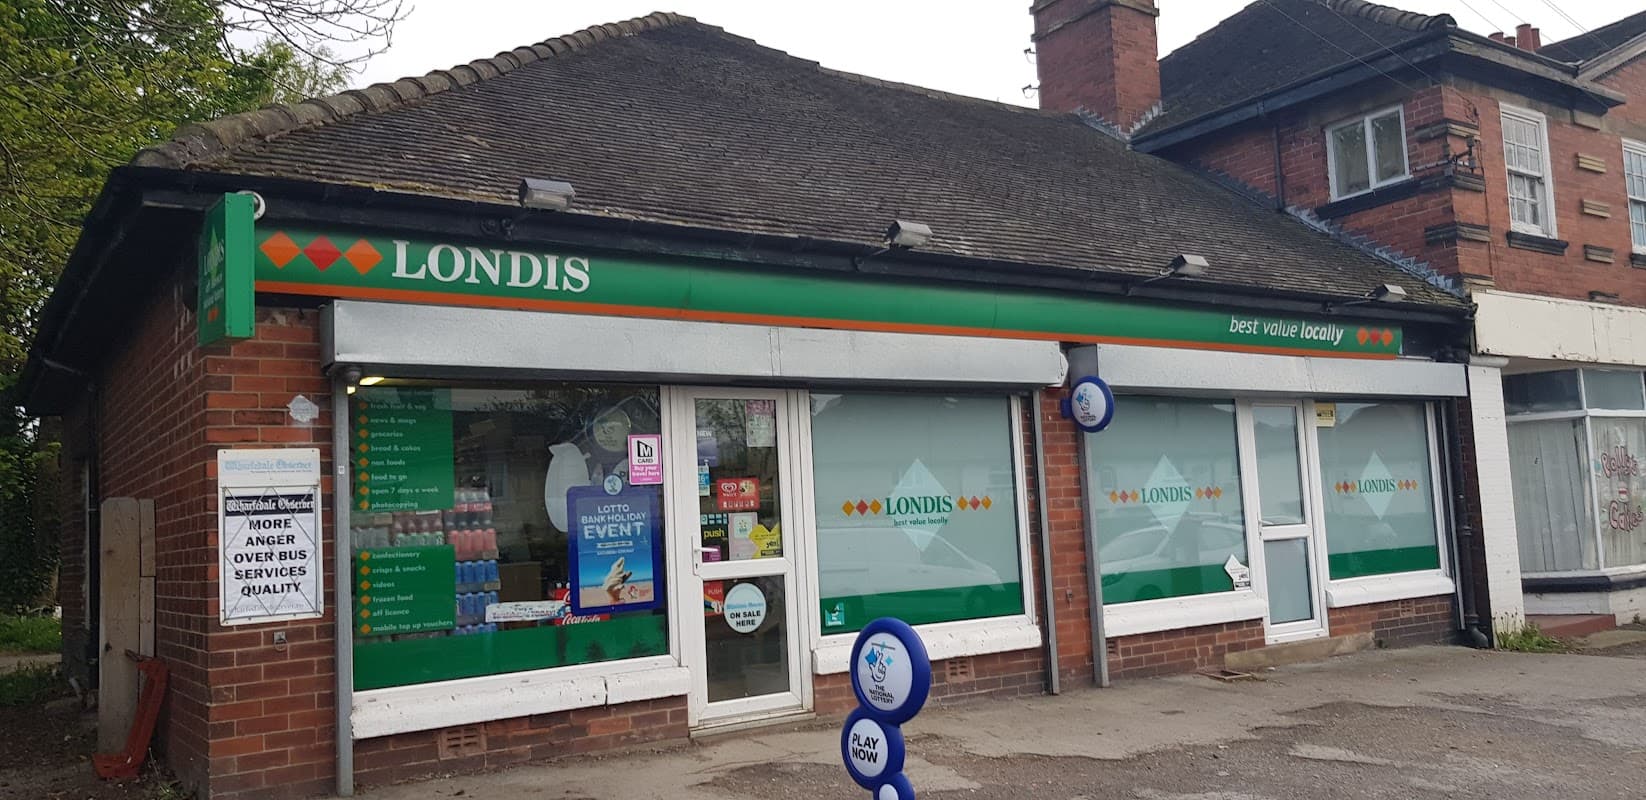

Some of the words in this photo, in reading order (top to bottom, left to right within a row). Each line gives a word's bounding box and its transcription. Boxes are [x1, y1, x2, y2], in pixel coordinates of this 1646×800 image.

[392, 240, 591, 293] LONDIS
[1229, 315, 1258, 334] best
[1263, 320, 1298, 338] value
[1300, 322, 1344, 346] locally
[1358, 479, 1396, 494] LONDIS
[1141, 486, 1192, 504] LONDIS
[226, 500, 276, 513] Wharfedale
[598, 504, 630, 514] LOTTO
[885, 495, 953, 515] LONDIS
[249, 518, 292, 530] MORE
[581, 515, 607, 524] BANK
[607, 512, 647, 523] HOLIDAY
[894, 518, 907, 526] best
[909, 517, 926, 525] value
[928, 516, 948, 525] locally
[583, 522, 645, 540] EVENT
[704, 528, 725, 540] push
[245, 534, 296, 547] ANGER
[234, 552, 274, 564] OVER
[279, 550, 307, 562] BUS
[234, 566, 307, 580] SERVICES
[241, 583, 301, 597] QUALITY
[742, 610, 761, 618] SALE
[736, 619, 756, 627] HERE
[869, 688, 894, 699] NATIONAL
[875, 684, 885, 692] THE
[870, 694, 893, 704] LOTTERY
[852, 733, 879, 750] PLAY
[852, 746, 878, 763] NOW
